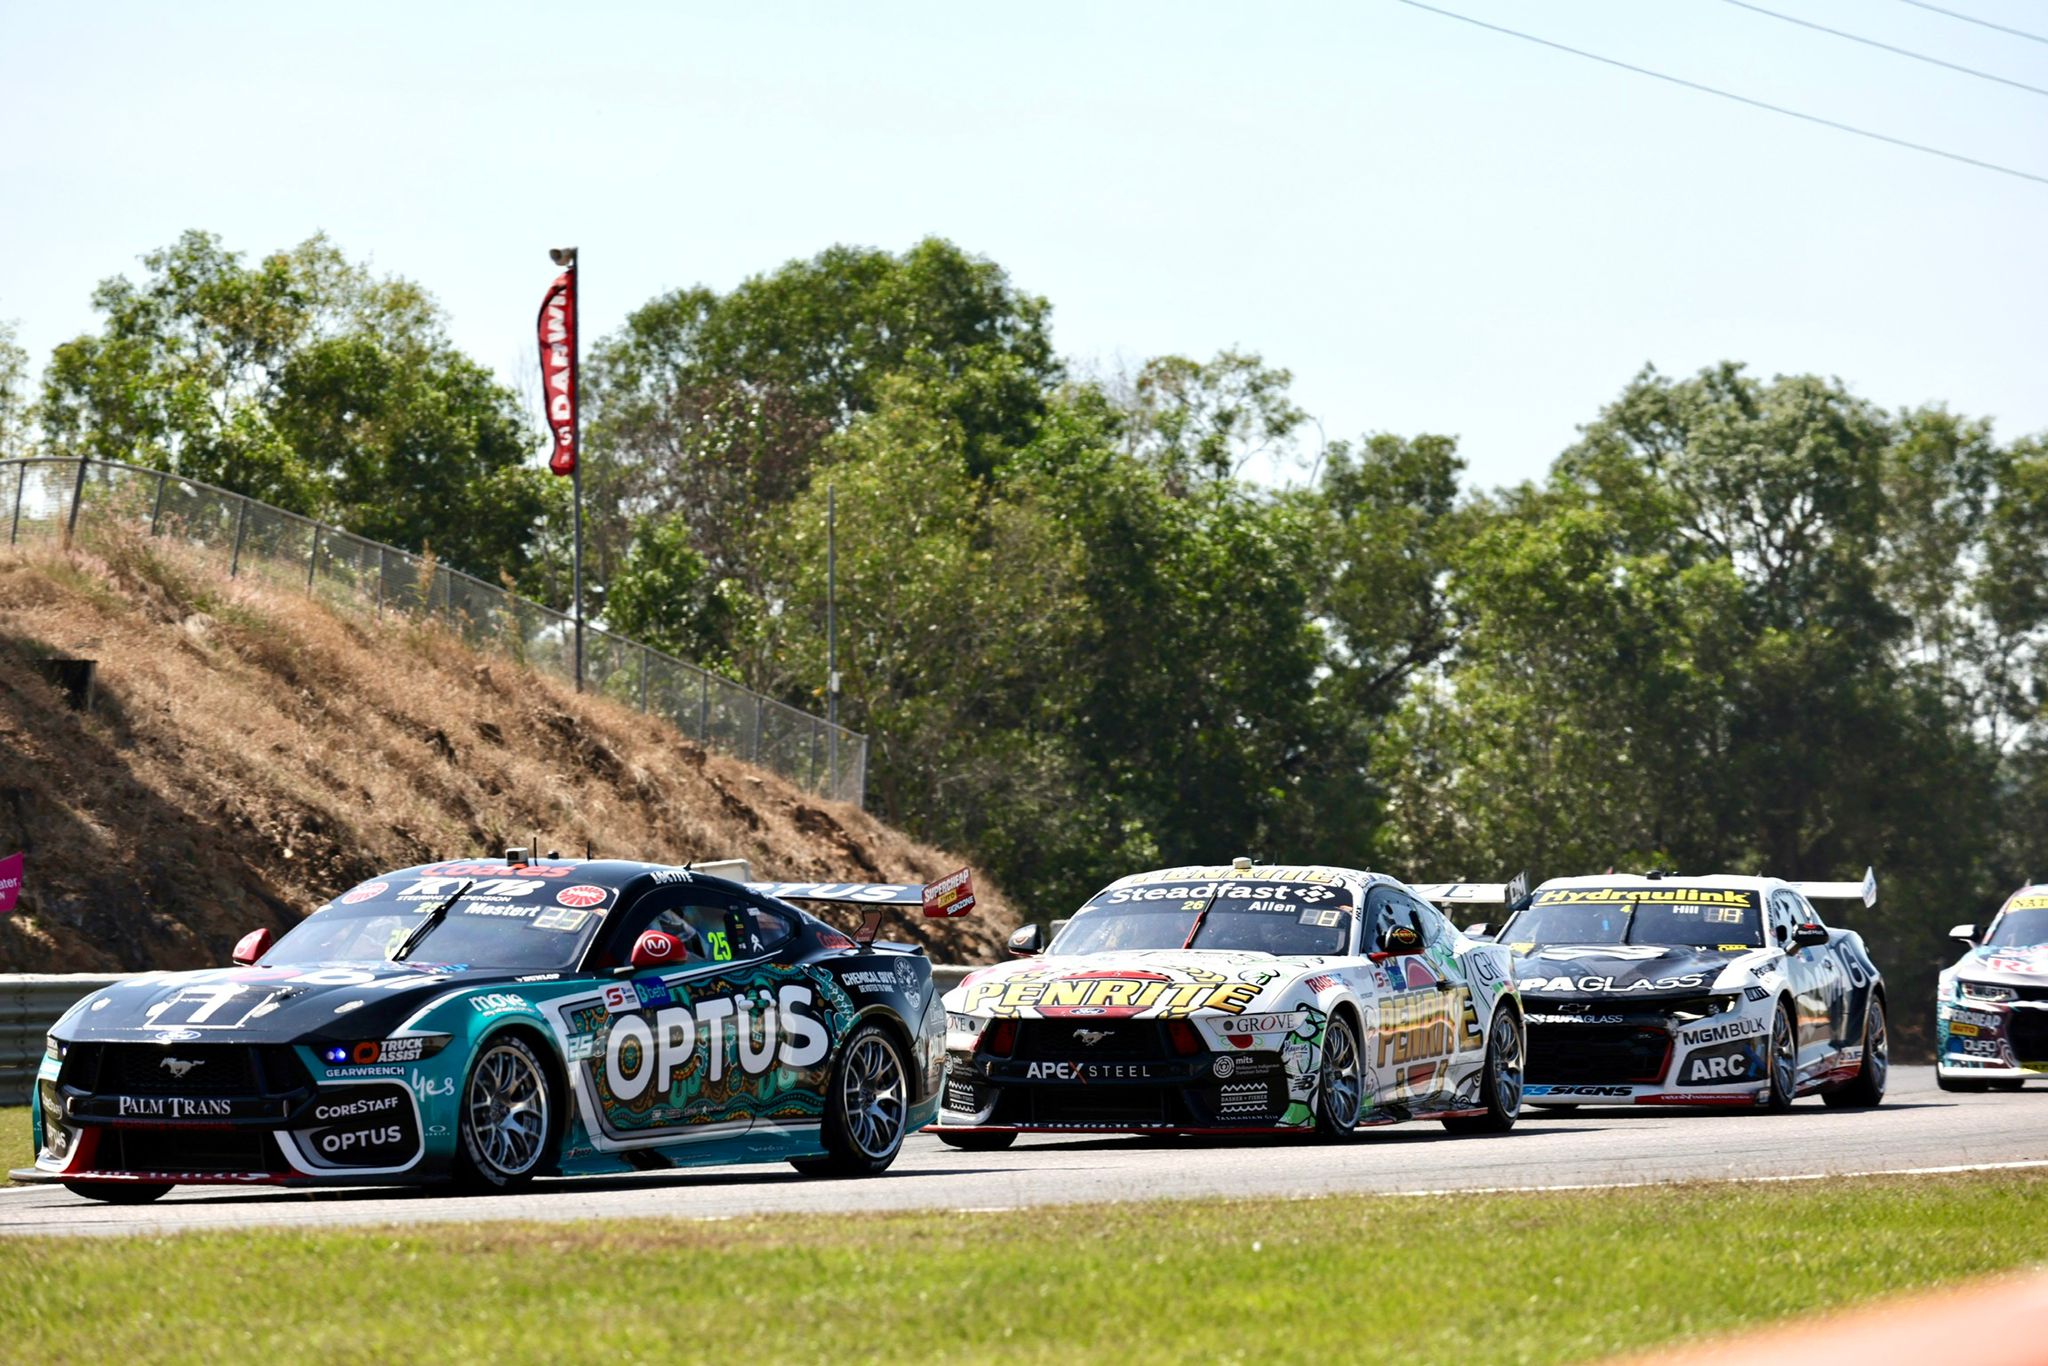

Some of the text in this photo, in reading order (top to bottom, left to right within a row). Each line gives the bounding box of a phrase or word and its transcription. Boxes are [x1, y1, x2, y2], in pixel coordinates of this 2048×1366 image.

[650, 870, 694, 885] LOCTITE
[924, 869, 970, 903] SUPERCHEAP
[1108, 882, 1292, 904] Steadfast
[1540, 888, 1748, 904] Hydraulink
[464, 902, 541, 917] Mostert
[946, 895, 974, 915] SIGNZONE
[1181, 900, 1296, 913] 26 Allen
[1620, 904, 1699, 914] 4 Hill
[707, 931, 732, 961] 25
[841, 971, 897, 986] CHEMICAL GUYS
[468, 993, 527, 1011] move
[963, 979, 1264, 1015] PENRITE
[1236, 1014, 1294, 1033] GROVE
[1546, 1014, 1624, 1024] SUPAGLASS
[1683, 1018, 1766, 1046] MGMBULK
[380, 1038, 424, 1051] TRUCK
[568, 1035, 594, 1061] 25
[605, 985, 829, 1100] OPTUS
[377, 1049, 422, 1063] ASSIST
[1235, 1056, 1253, 1065] mits
[326, 1066, 405, 1078] GEARWRENCH
[1026, 1061, 1151, 1084] APEX STEEL
[1691, 1054, 1745, 1081] ARC
[118, 1096, 232, 1118] PALM TRANS
[322, 1125, 401, 1152] OPTUS
